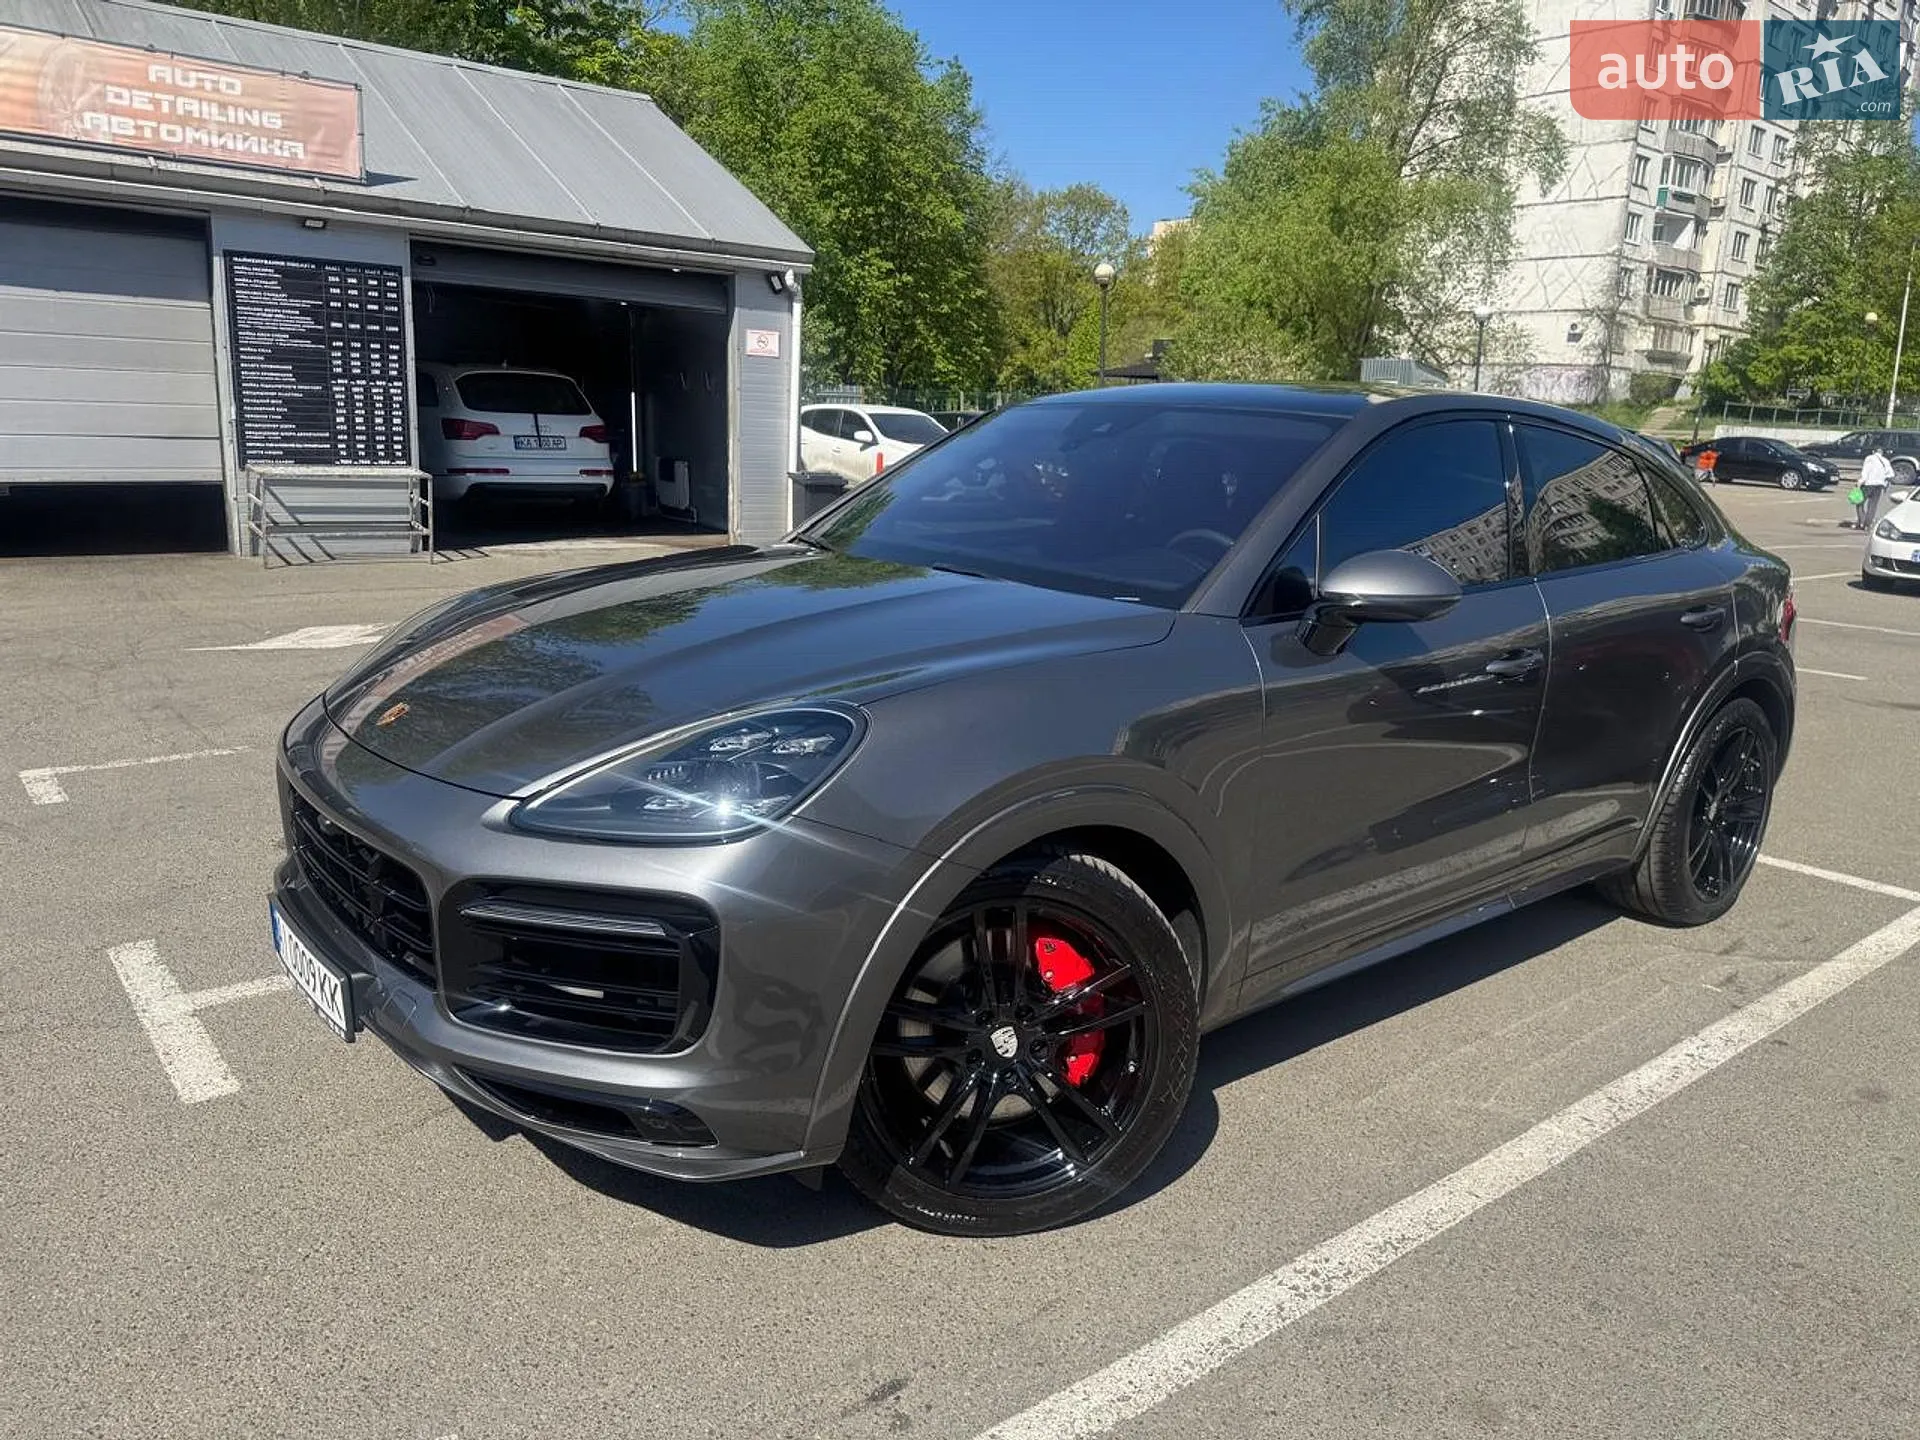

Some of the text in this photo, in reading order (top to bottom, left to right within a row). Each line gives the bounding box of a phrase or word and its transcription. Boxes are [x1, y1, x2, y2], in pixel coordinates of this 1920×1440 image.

[148, 64, 242, 96] AUTO
[105, 84, 283, 129] DETAILING
[82, 111, 305, 159] АВТОМИЙКА
